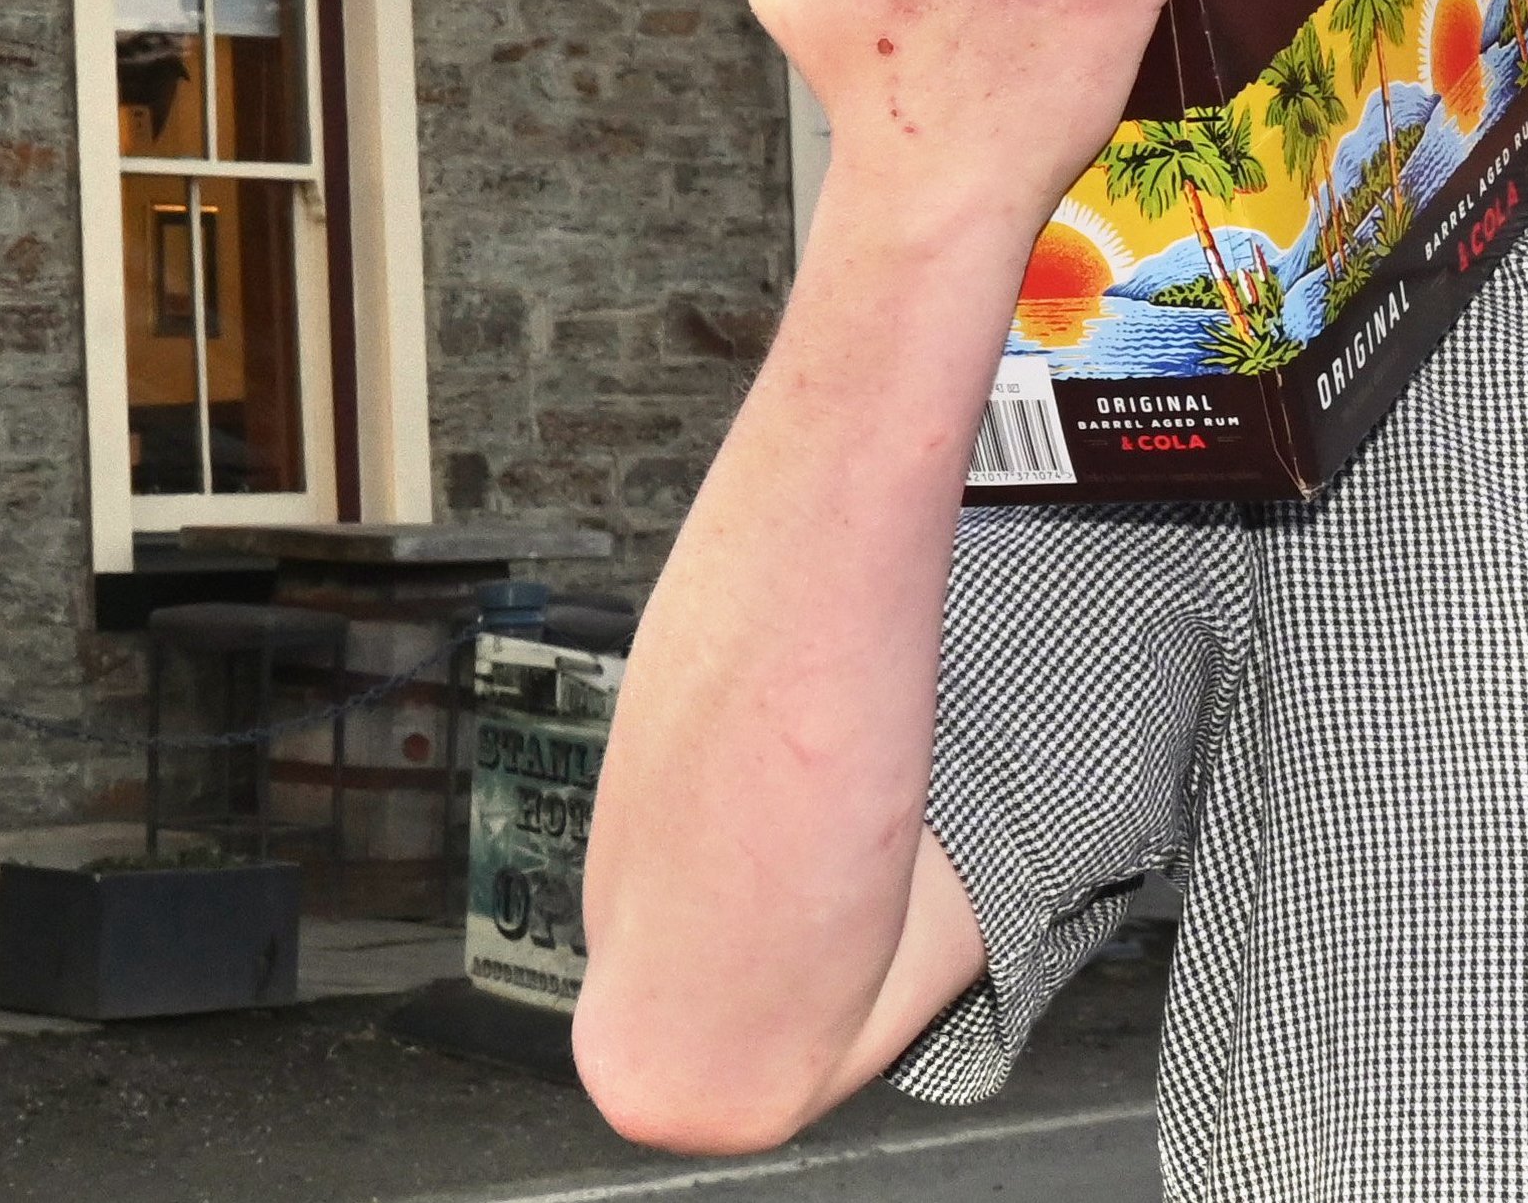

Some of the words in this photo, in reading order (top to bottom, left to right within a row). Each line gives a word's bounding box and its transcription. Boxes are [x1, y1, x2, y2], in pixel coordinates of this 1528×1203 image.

[1425, 193, 1475, 261] BARREL
[1479, 148, 1511, 196] AGED
[1471, 180, 1520, 256] COLA
[1316, 280, 1411, 410] ORIGINAL
[1078, 419, 1144, 430] BARREL
[1151, 418, 1195, 428] AGED
[1204, 416, 1240, 426] RUM
[1097, 394, 1213, 414] ORIGINAL
[1137, 434, 1207, 451] COLA
[477, 724, 607, 790] STANL
[515, 785, 594, 840] HOT
[494, 867, 589, 957] OP
